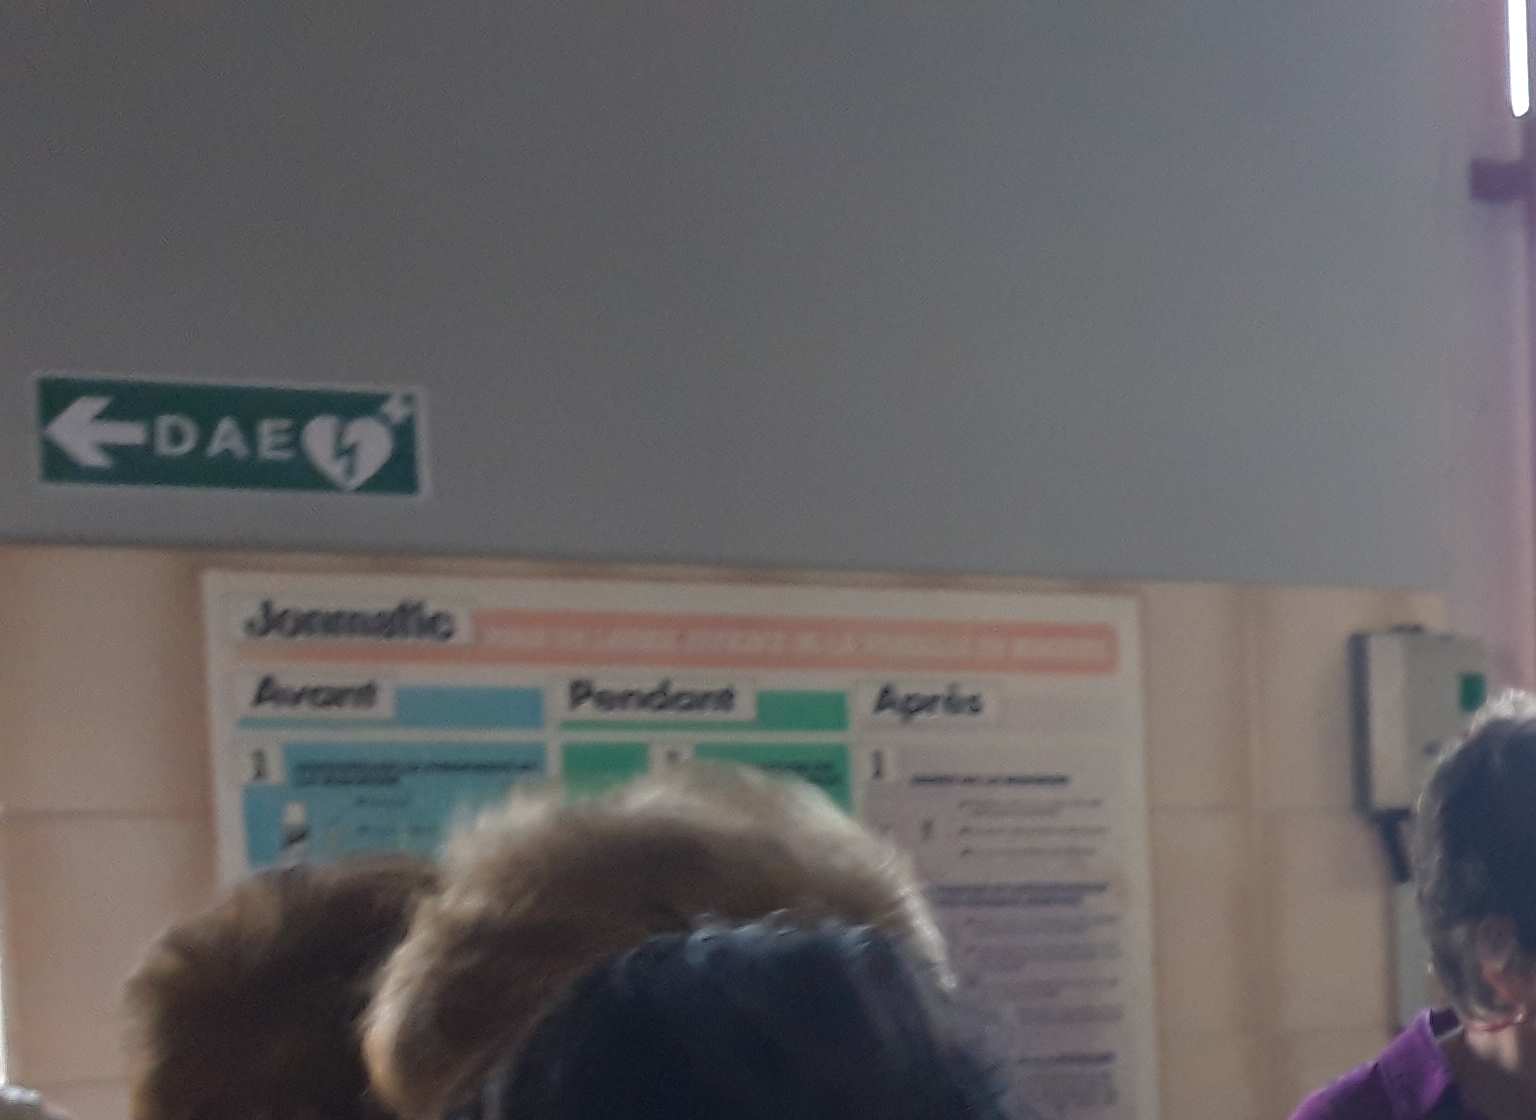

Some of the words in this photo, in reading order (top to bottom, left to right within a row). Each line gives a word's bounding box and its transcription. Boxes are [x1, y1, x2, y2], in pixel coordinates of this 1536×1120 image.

[153, 413, 297, 461] DAE
[251, 674, 378, 707] Avant
[568, 678, 736, 713] Pendant
[873, 682, 984, 724] Après
